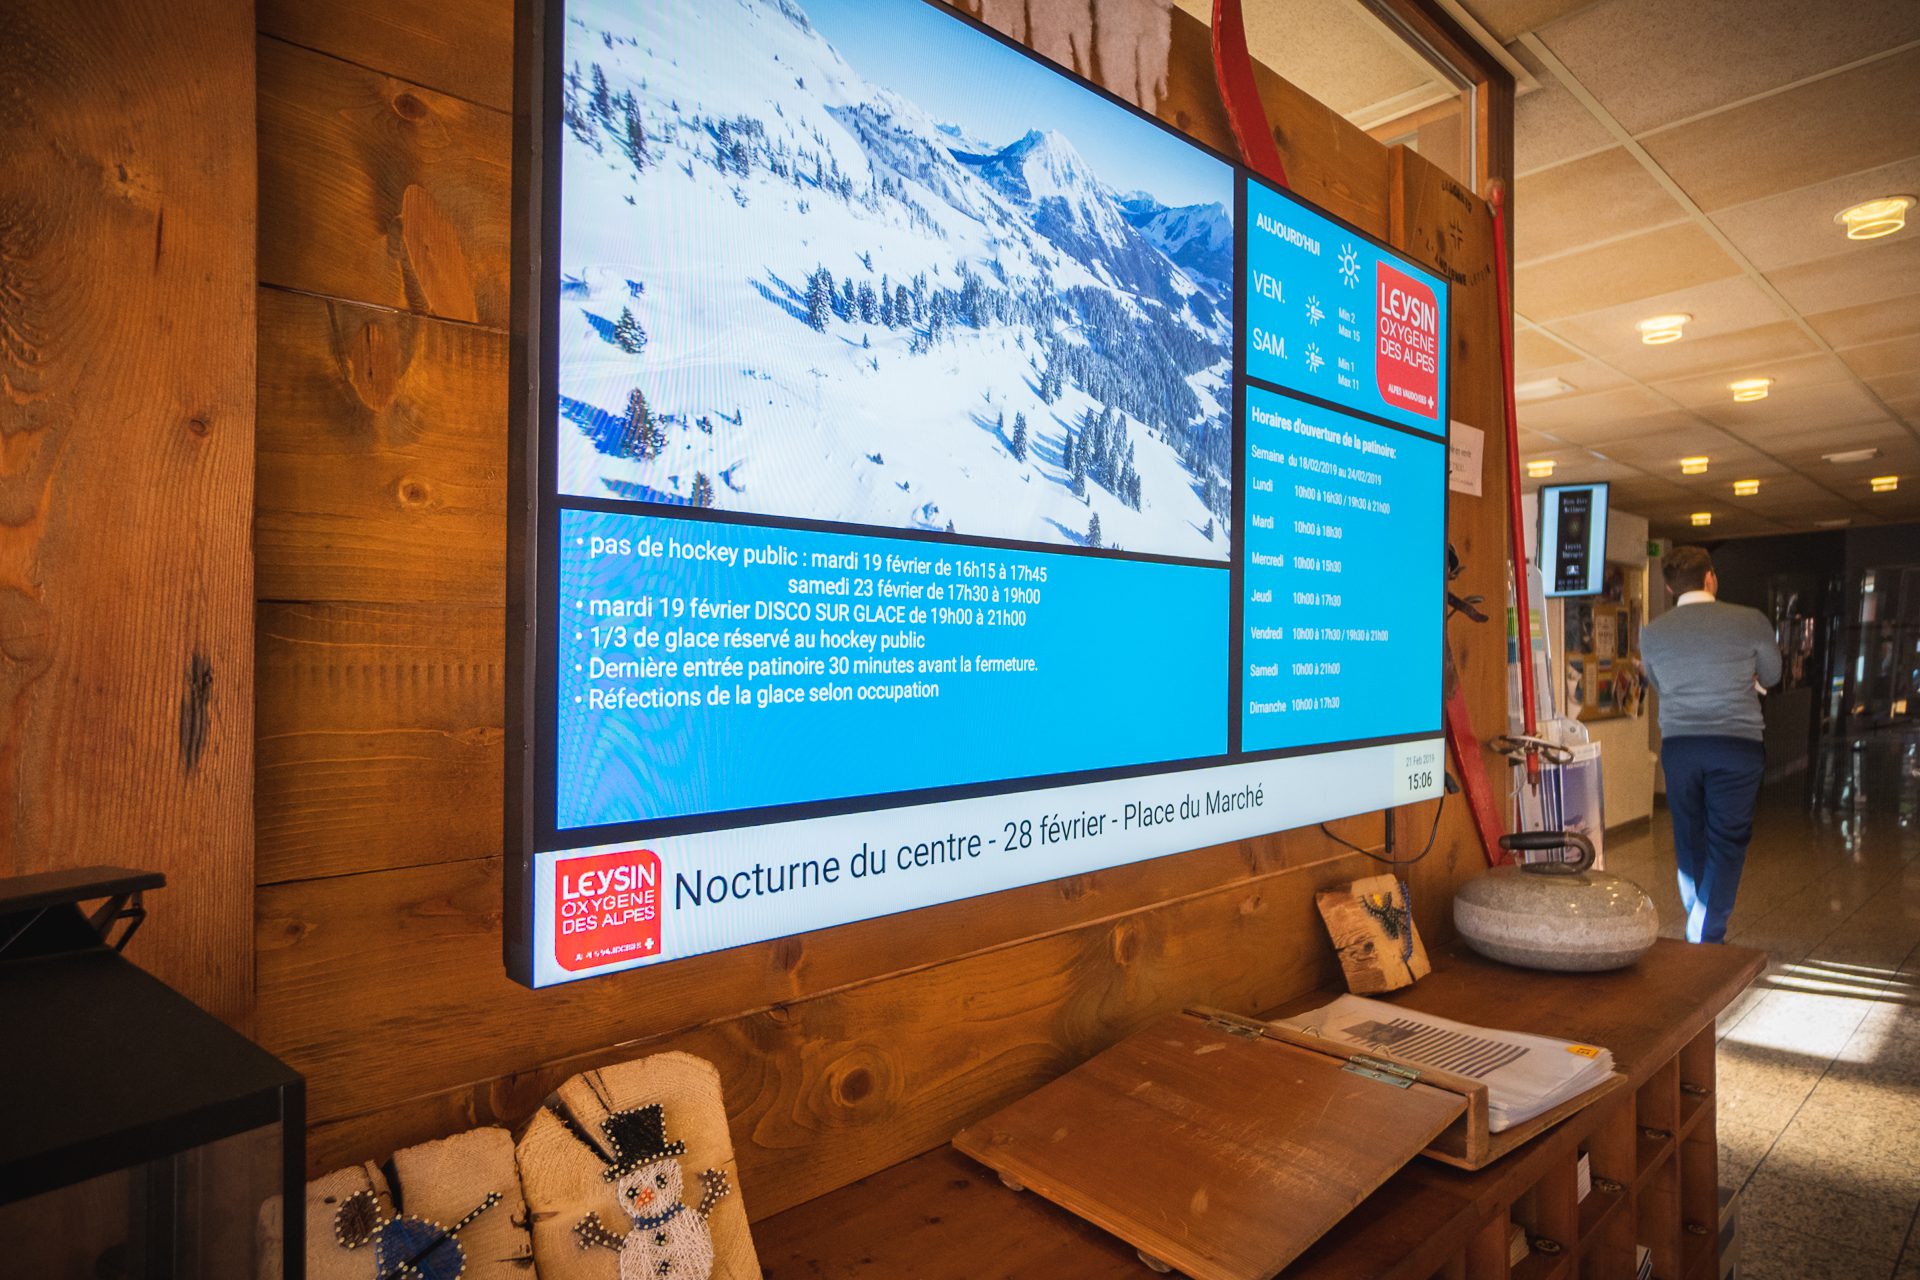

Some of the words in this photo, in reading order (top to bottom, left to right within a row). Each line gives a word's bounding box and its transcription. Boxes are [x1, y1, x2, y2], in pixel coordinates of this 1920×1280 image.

[1256, 212, 1321, 256] AUJOURD'HUI
[1253, 270, 1286, 304] VEN.
[1338, 307, 1350, 322] Min
[1350, 311, 1356, 325] 2
[1253, 327, 1288, 360] SAM.
[1338, 324, 1351, 339] Max
[1351, 327, 1360, 342] 15
[1380, 316, 1435, 355] OXYGENE
[1338, 357, 1350, 371] Min
[1380, 338, 1402, 361] DES
[1403, 348, 1435, 375] ALPES
[1338, 374, 1351, 388] Max
[1351, 377, 1360, 391] 11
[1252, 406, 1292, 432] Horaires
[1293, 418, 1341, 445] d'ouverture
[1342, 431, 1353, 448] de
[1353, 434, 1361, 450] la
[1252, 444, 1285, 464] Semaine
[1288, 454, 1298, 467] du
[1299, 456, 1337, 476] 18/02/2019
[1338, 467, 1347, 479] au
[1347, 468, 1382, 486] 24/02/2019
[1252, 477, 1274, 493] Lundi
[1295, 485, 1316, 500] 10h00
[1372, 501, 1391, 515] 21h00
[1252, 514, 1274, 529] Mardi
[1294, 521, 1315, 536] 10h00
[590, 536, 632, 559] pas
[638, 535, 664, 557] de
[669, 538, 738, 567] hockey
[743, 544, 798, 568] public
[811, 551, 858, 570] mardi
[863, 553, 882, 571] 19
[886, 556, 932, 574] février
[935, 558, 952, 576] de
[955, 560, 996, 579] 16h15
[999, 563, 1007, 580] à
[1010, 564, 1047, 583] 17h45
[1252, 552, 1284, 568] Mercredi
[1294, 556, 1315, 571] 10h00
[788, 577, 849, 596] samedi
[853, 578, 873, 597] 23
[877, 579, 923, 599] février
[926, 581, 944, 600] de
[948, 583, 989, 602] 17h30
[992, 585, 1000, 603] à
[1003, 587, 1041, 604] 19h00
[1251, 589, 1272, 603] Jeudi
[1293, 592, 1314, 606] 10h00
[1321, 594, 1341, 607] 17h30
[590, 596, 653, 618] mardi
[659, 598, 685, 618] 19
[690, 598, 750, 620] février
[755, 600, 810, 621] DISCO
[816, 603, 850, 623] SUR
[853, 605, 906, 624] GLACE
[909, 606, 927, 625] de
[931, 607, 973, 625] 19h00
[976, 608, 984, 626] à
[987, 609, 1027, 627] 21h00
[590, 626, 627, 649] 1/3
[634, 626, 659, 648] de
[665, 627, 719, 652] glace
[724, 628, 790, 649] réservé
[794, 632, 815, 648] au
[820, 629, 877, 652] hockey
[881, 630, 926, 652] public
[1251, 626, 1283, 640] Vendredi
[1293, 627, 1314, 640] 10h00
[1321, 628, 1341, 641] 17h30
[1370, 630, 1388, 642] 21h00
[589, 656, 677, 679] Dernière
[683, 656, 743, 677] entrée
[748, 657, 825, 680] patinoire
[829, 656, 849, 675] 30
[853, 656, 914, 674] minutes
[918, 656, 957, 673] avant
[960, 655, 972, 672] la
[975, 655, 1039, 672] fermeture.
[1250, 664, 1278, 677] Samedi
[1292, 663, 1313, 676] 10h00
[1320, 662, 1341, 675] 21h00
[589, 687, 701, 710] Réfections
[707, 684, 731, 706] de
[735, 684, 751, 705] la
[757, 684, 805, 708] glace
[809, 682, 853, 702] selon
[857, 681, 939, 703] occupation
[1249, 700, 1286, 714] Dimanche
[1292, 698, 1313, 711] 10h00
[1320, 696, 1340, 709] 17h30
[1408, 770, 1432, 791] 15:06
[675, 856, 840, 909] Nocturne
[850, 842, 886, 877] du
[897, 832, 982, 869] centre
[1004, 819, 1032, 851] 28
[1040, 810, 1107, 845] février
[1124, 801, 1175, 830] Place
[1180, 793, 1200, 820] du
[1206, 782, 1264, 816] Marché
[562, 862, 656, 900] LEYSIN
[561, 889, 655, 917] OXYGENE
[562, 914, 598, 935] DES
[602, 905, 655, 927] ALPES
